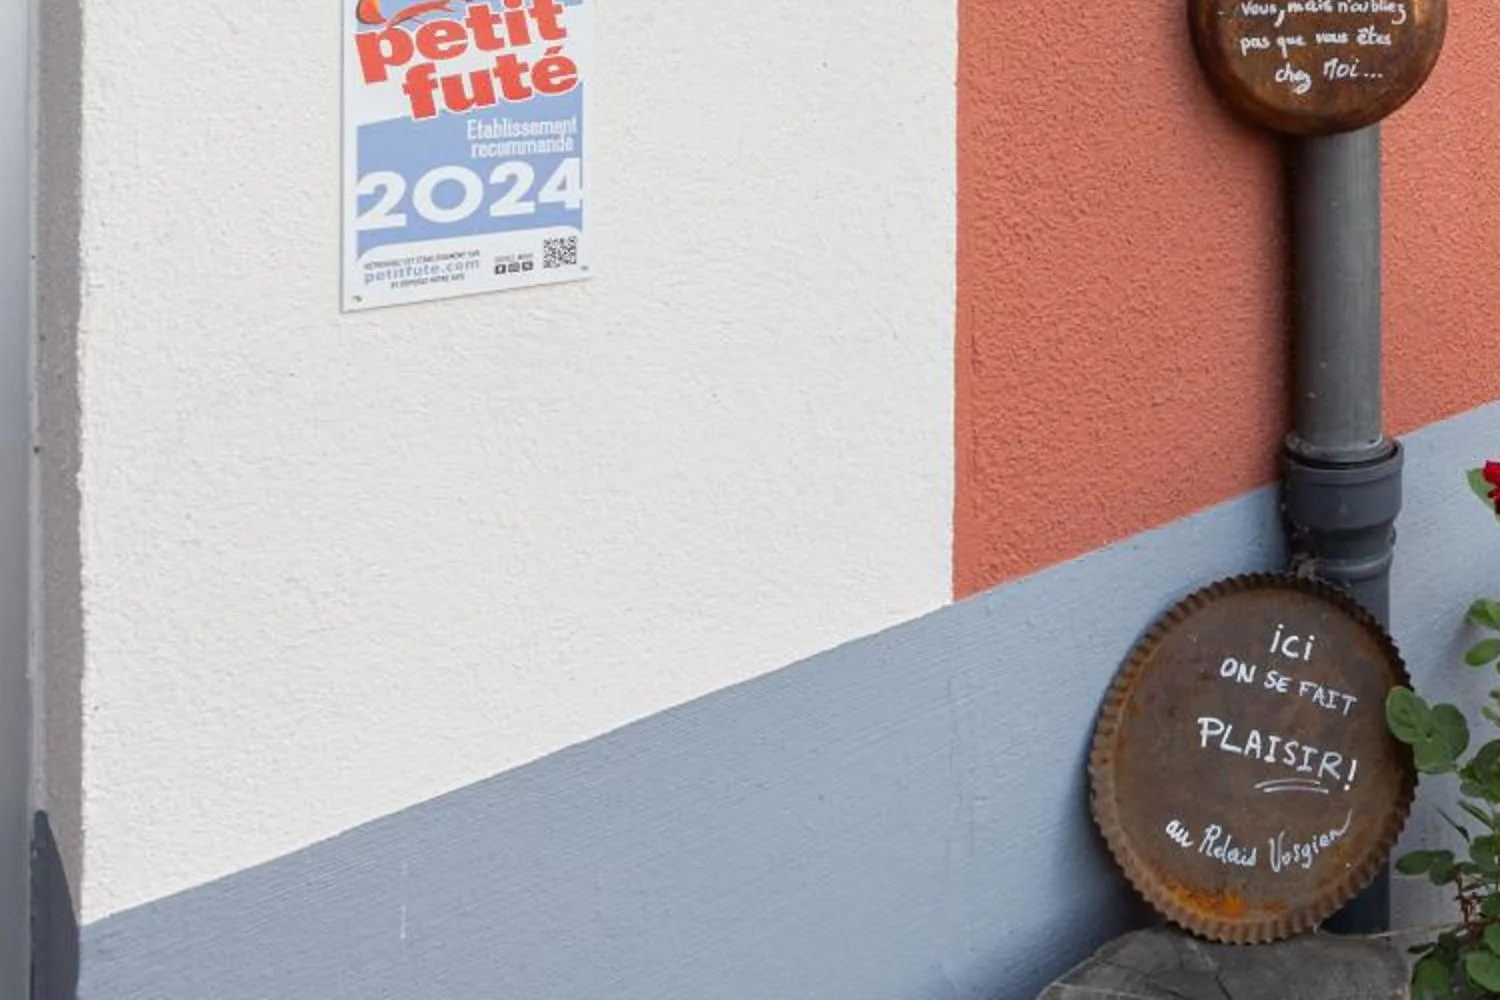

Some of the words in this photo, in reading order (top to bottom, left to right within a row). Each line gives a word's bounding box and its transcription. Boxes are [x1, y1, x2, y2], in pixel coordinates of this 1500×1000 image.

[1287, 0, 1332, 14] mais
[1240, 34, 1270, 56] pas
[1276, 35, 1306, 58] que
[1315, 31, 1349, 45] vous
[402, 46, 578, 120] futé
[1275, 62, 1312, 94] chez
[356, 158, 581, 231] 2024
[1220, 657, 1257, 684] ON
[1263, 669, 1292, 693] SE
[1299, 681, 1358, 716] FAIT
[1166, 818, 1195, 848] au
